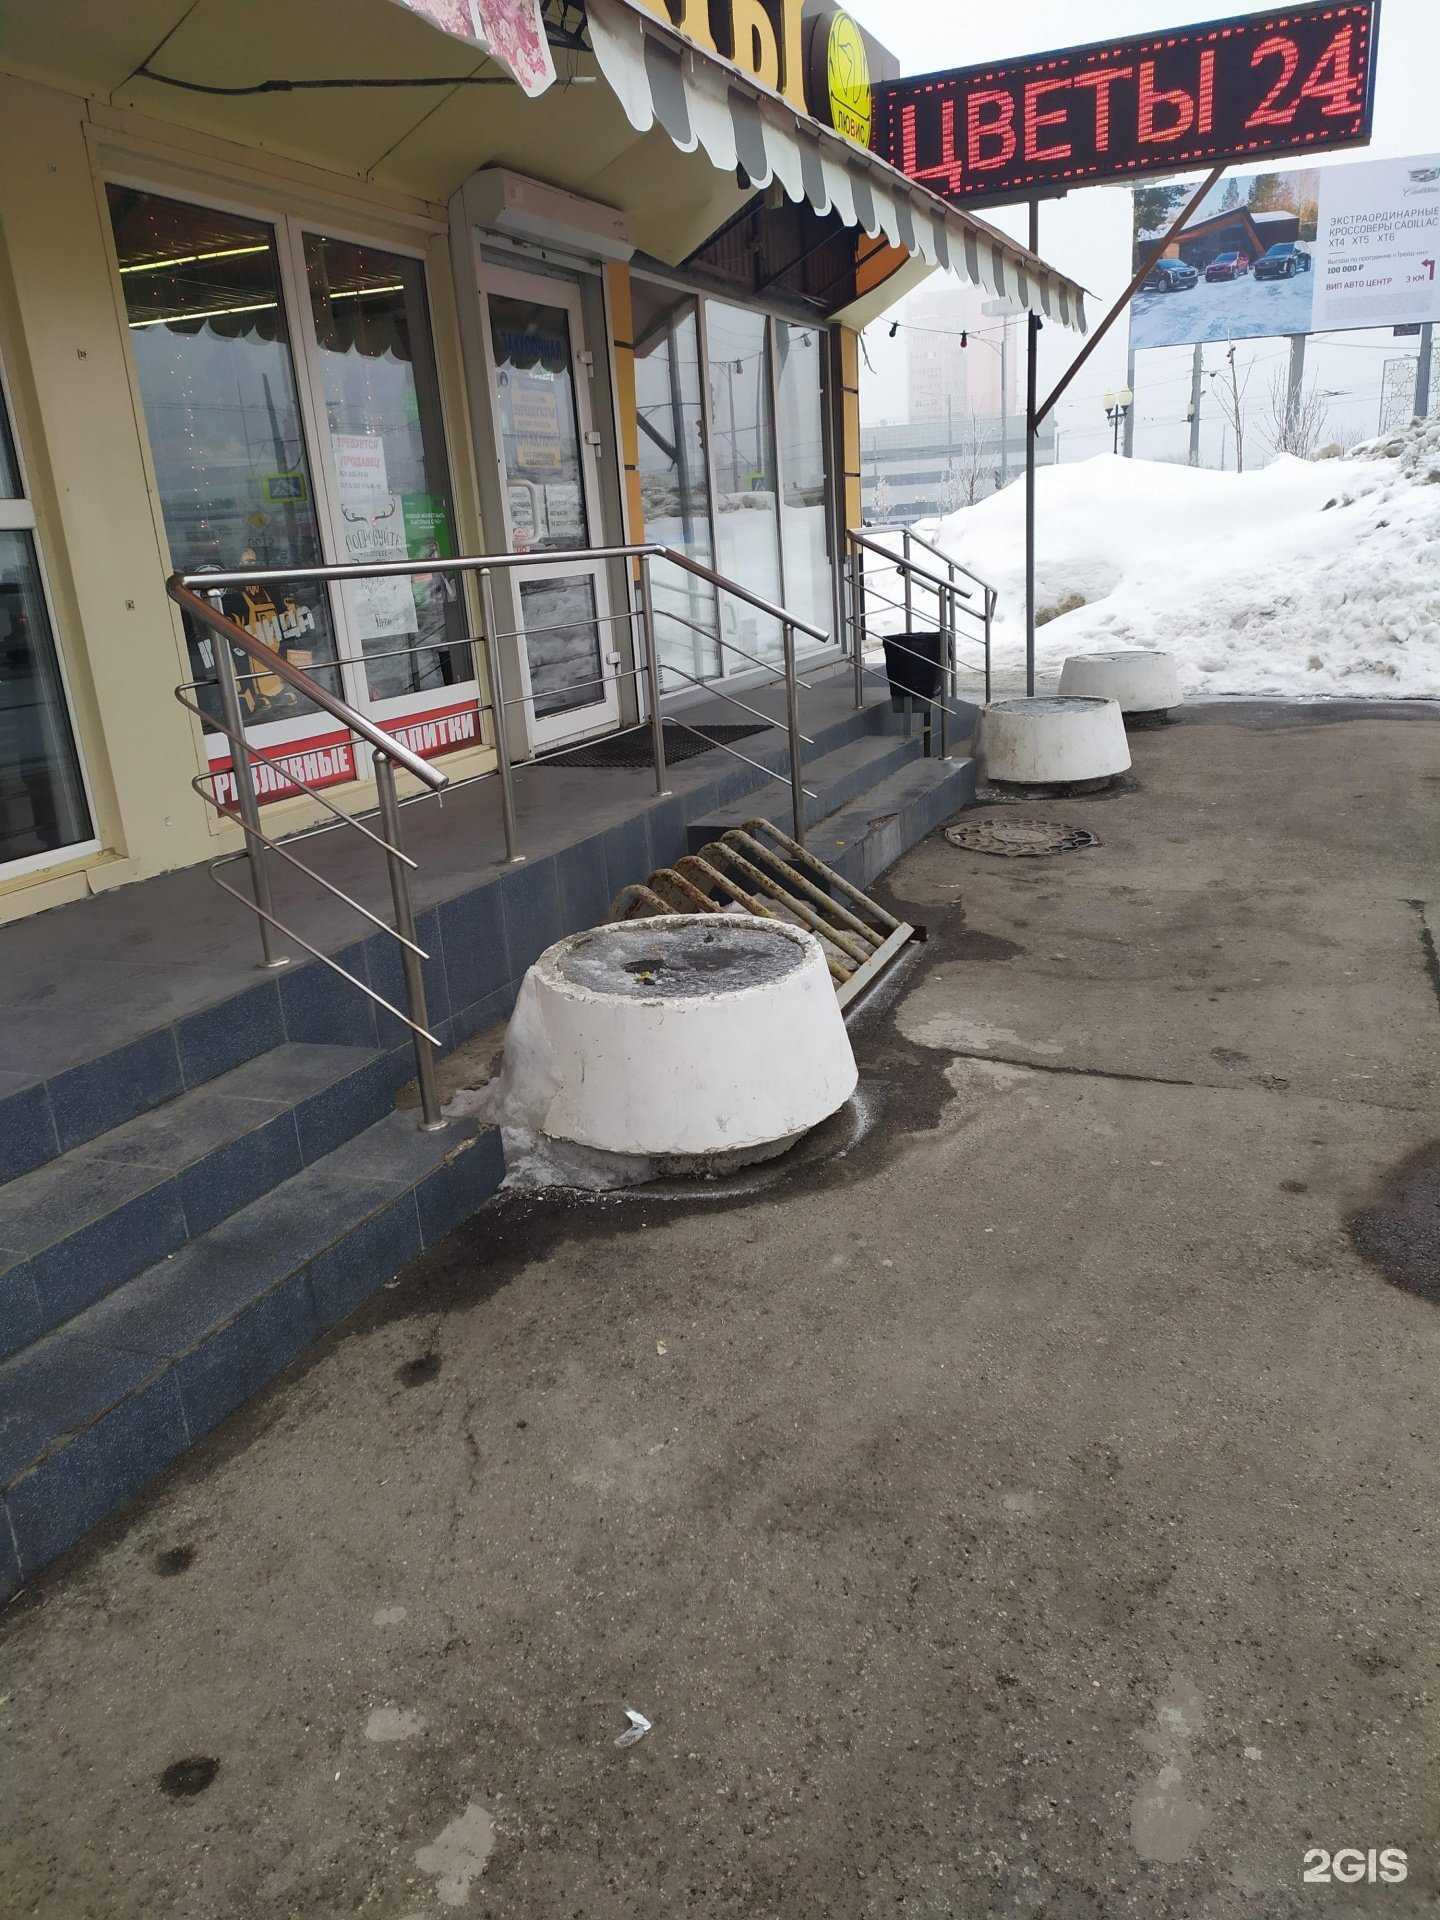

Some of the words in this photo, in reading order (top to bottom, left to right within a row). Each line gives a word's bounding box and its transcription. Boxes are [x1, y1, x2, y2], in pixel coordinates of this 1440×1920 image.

[901, 50, 1216, 196] ЦВЕТЫ
[1243, 24, 1364, 129] 24
[1329, 206, 1440, 227] ЭКСТРАОРДИНАРНЫЕ
[1329, 222, 1393, 238] КРОССОВЕРЫ
[1394, 217, 1439, 231] CADILLAC
[1326, 281, 1343, 291] ВИП
[1343, 279, 1365, 289] АВТО
[1366, 277, 1393, 287] ЦЕНТР
